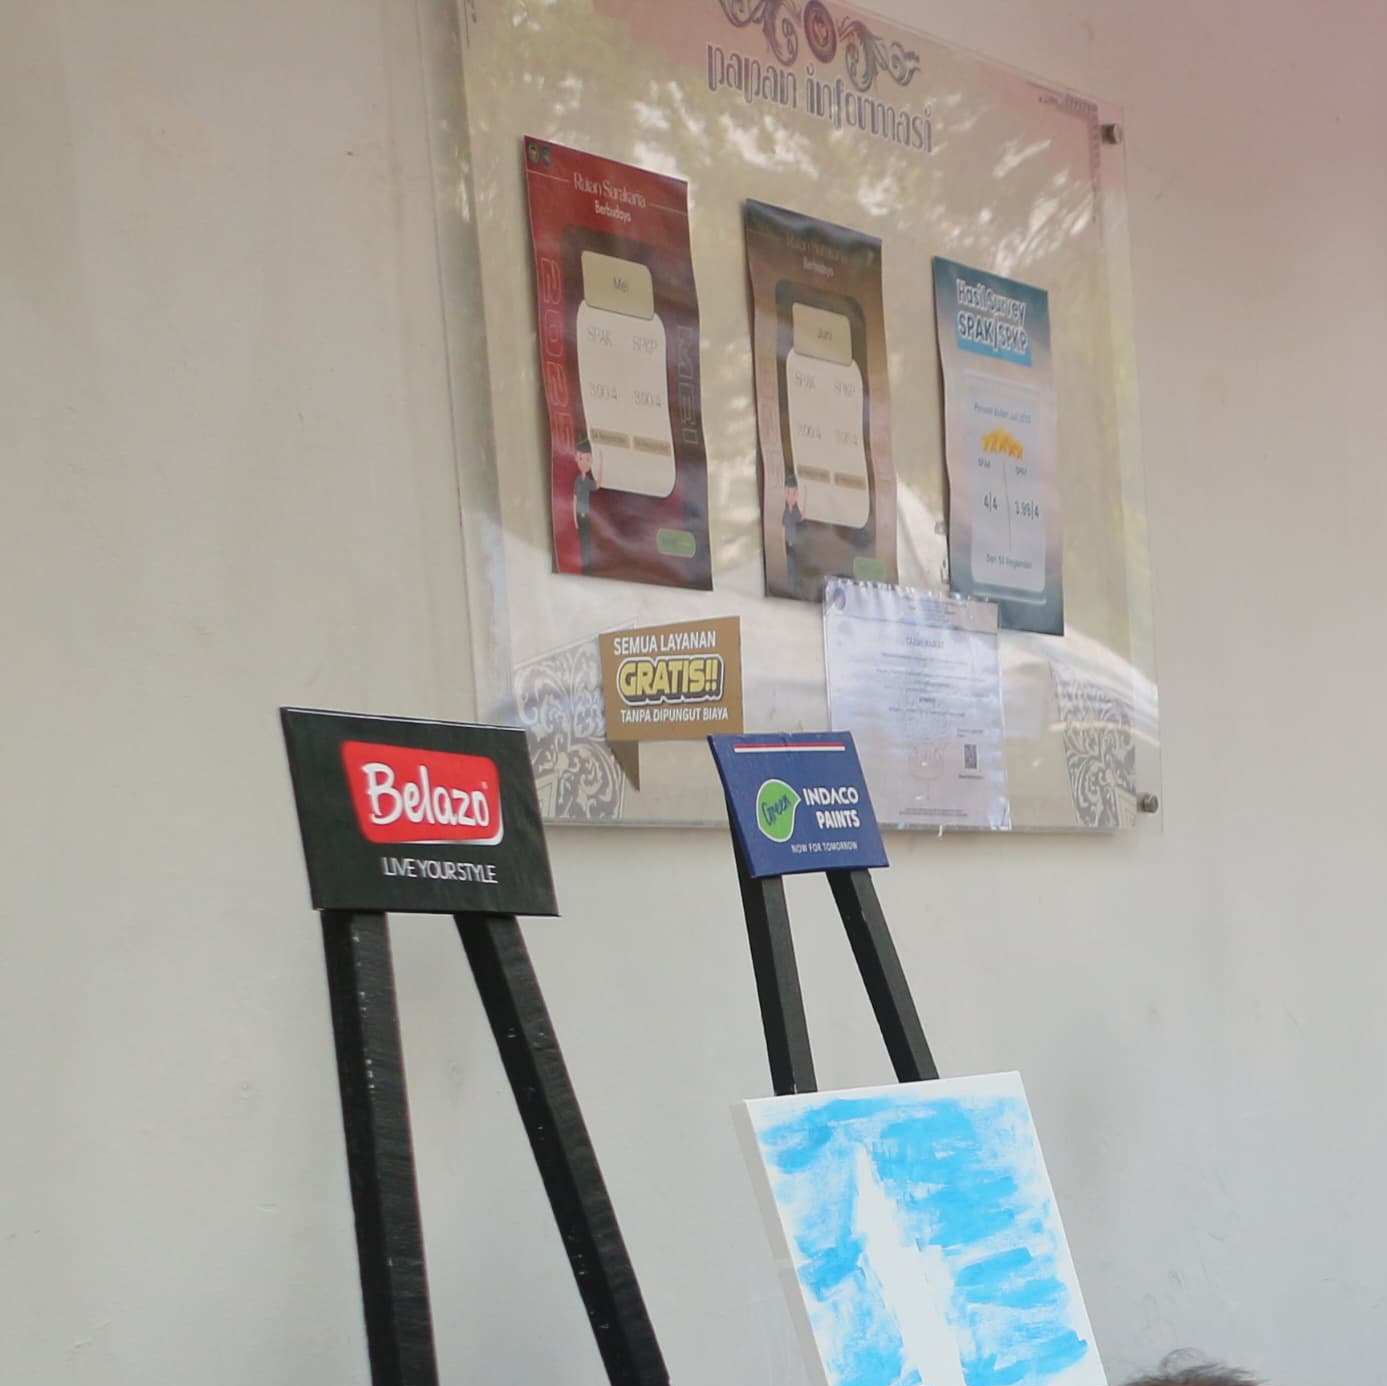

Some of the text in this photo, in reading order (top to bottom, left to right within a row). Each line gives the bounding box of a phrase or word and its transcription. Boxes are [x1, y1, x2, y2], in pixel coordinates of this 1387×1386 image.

[706, 45, 933, 153] papan informasi
[956, 278, 1026, 325] Hasil Survey
[613, 630, 716, 656] SEMUA LAYANAN
[618, 657, 720, 699] GRATIS!!
[620, 706, 729, 724] TANPA DIPUNGUT BIAYA
[361, 761, 490, 828] Belazo
[802, 786, 860, 807] INDACO
[815, 809, 861, 830] PAINTS
[790, 841, 859, 854] NOW FOR TOMORROW
